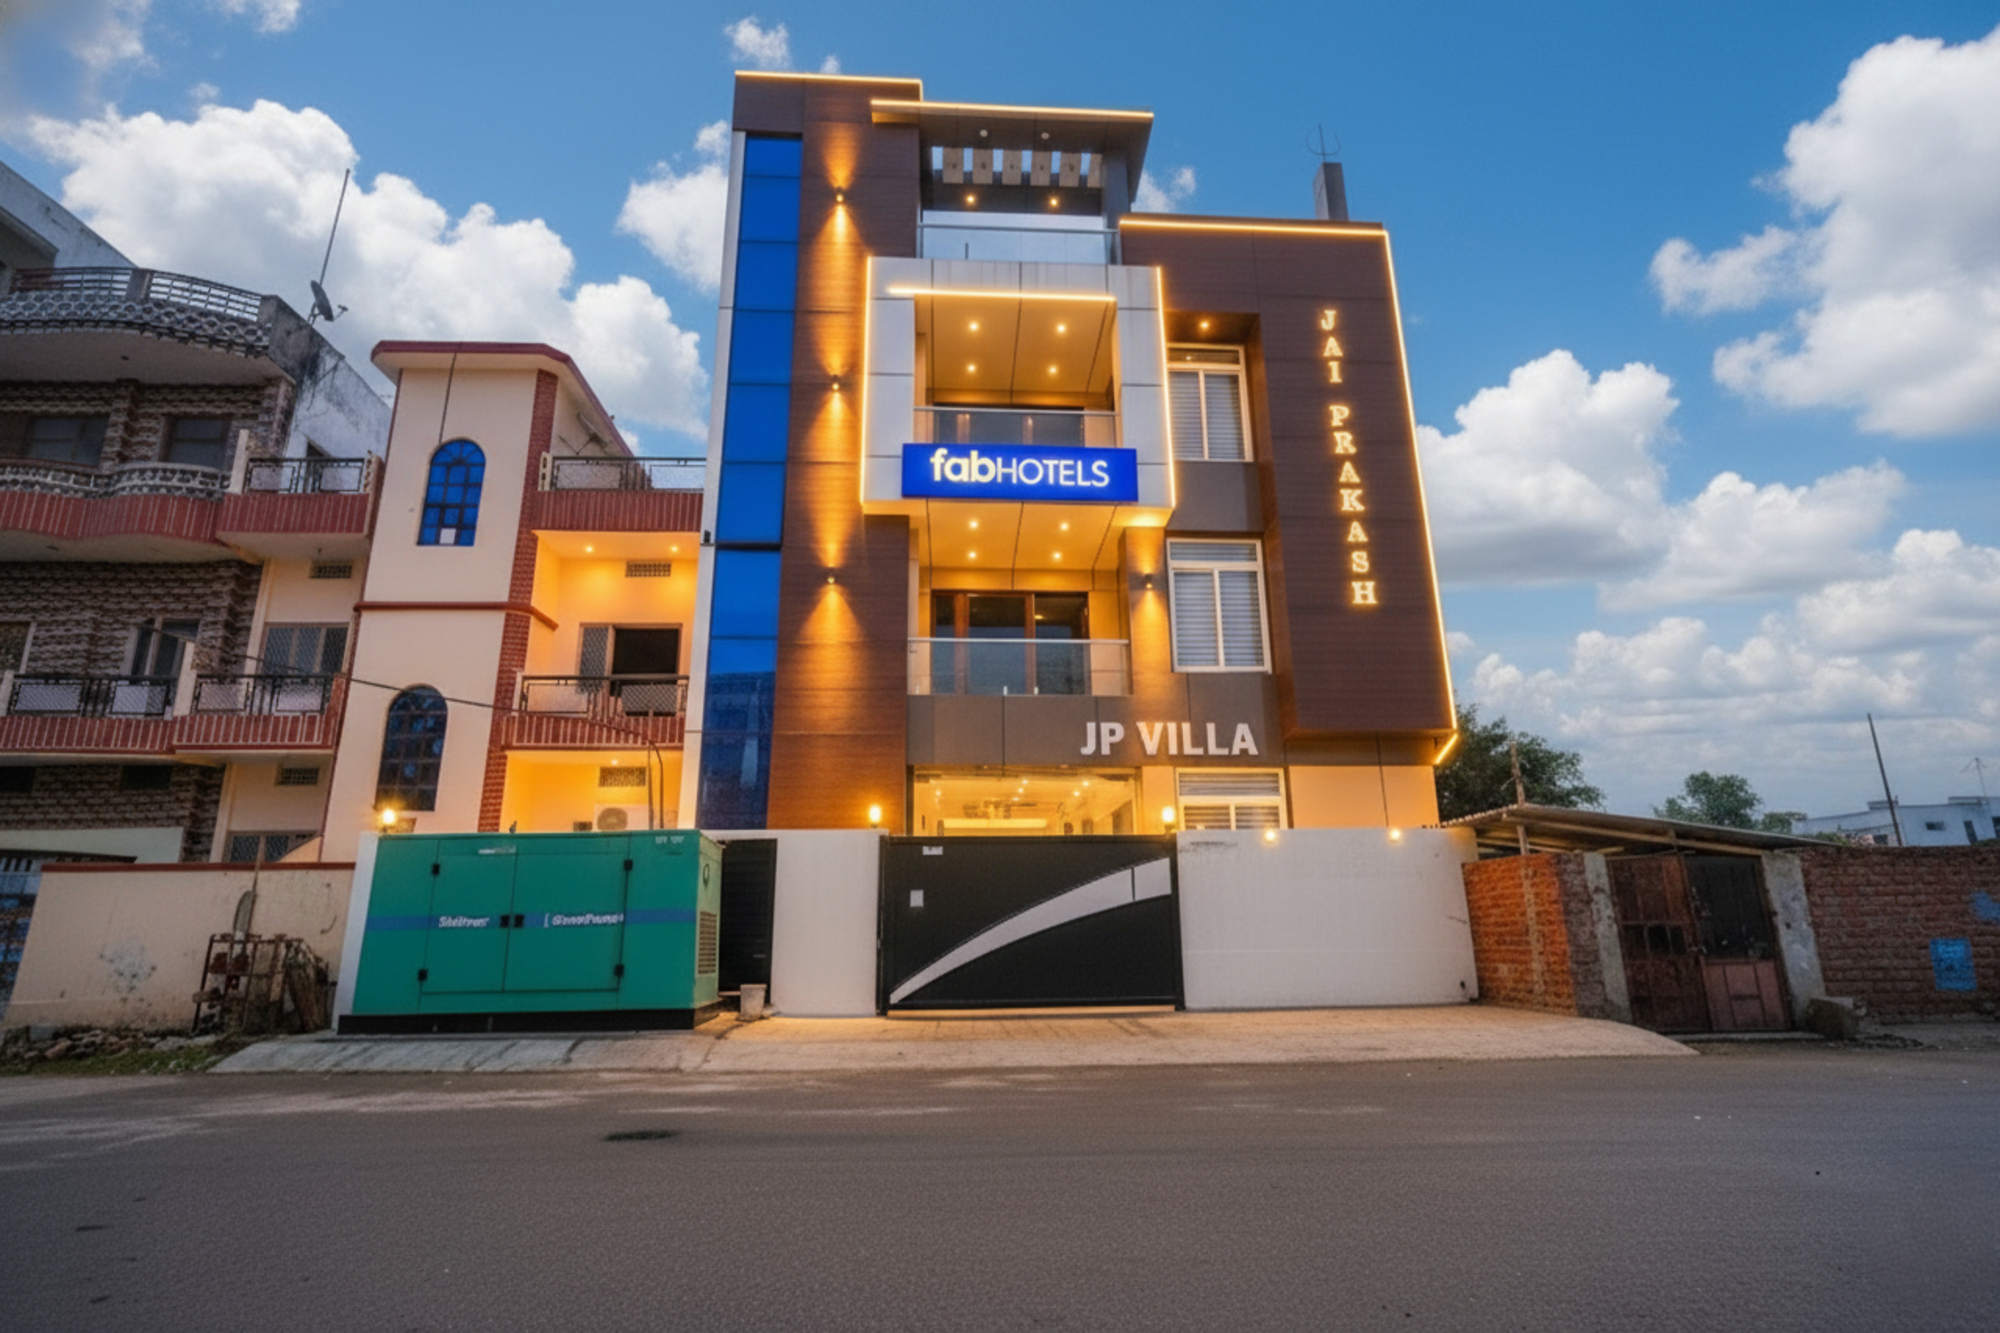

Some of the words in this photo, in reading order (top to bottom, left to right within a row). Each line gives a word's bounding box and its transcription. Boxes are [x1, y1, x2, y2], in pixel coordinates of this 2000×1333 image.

[1320, 309, 1343, 383] JAI
[1329, 405, 1378, 604] PRAKASH
[1080, 721, 1125, 755] JP
[1135, 721, 1259, 756] VILLA
